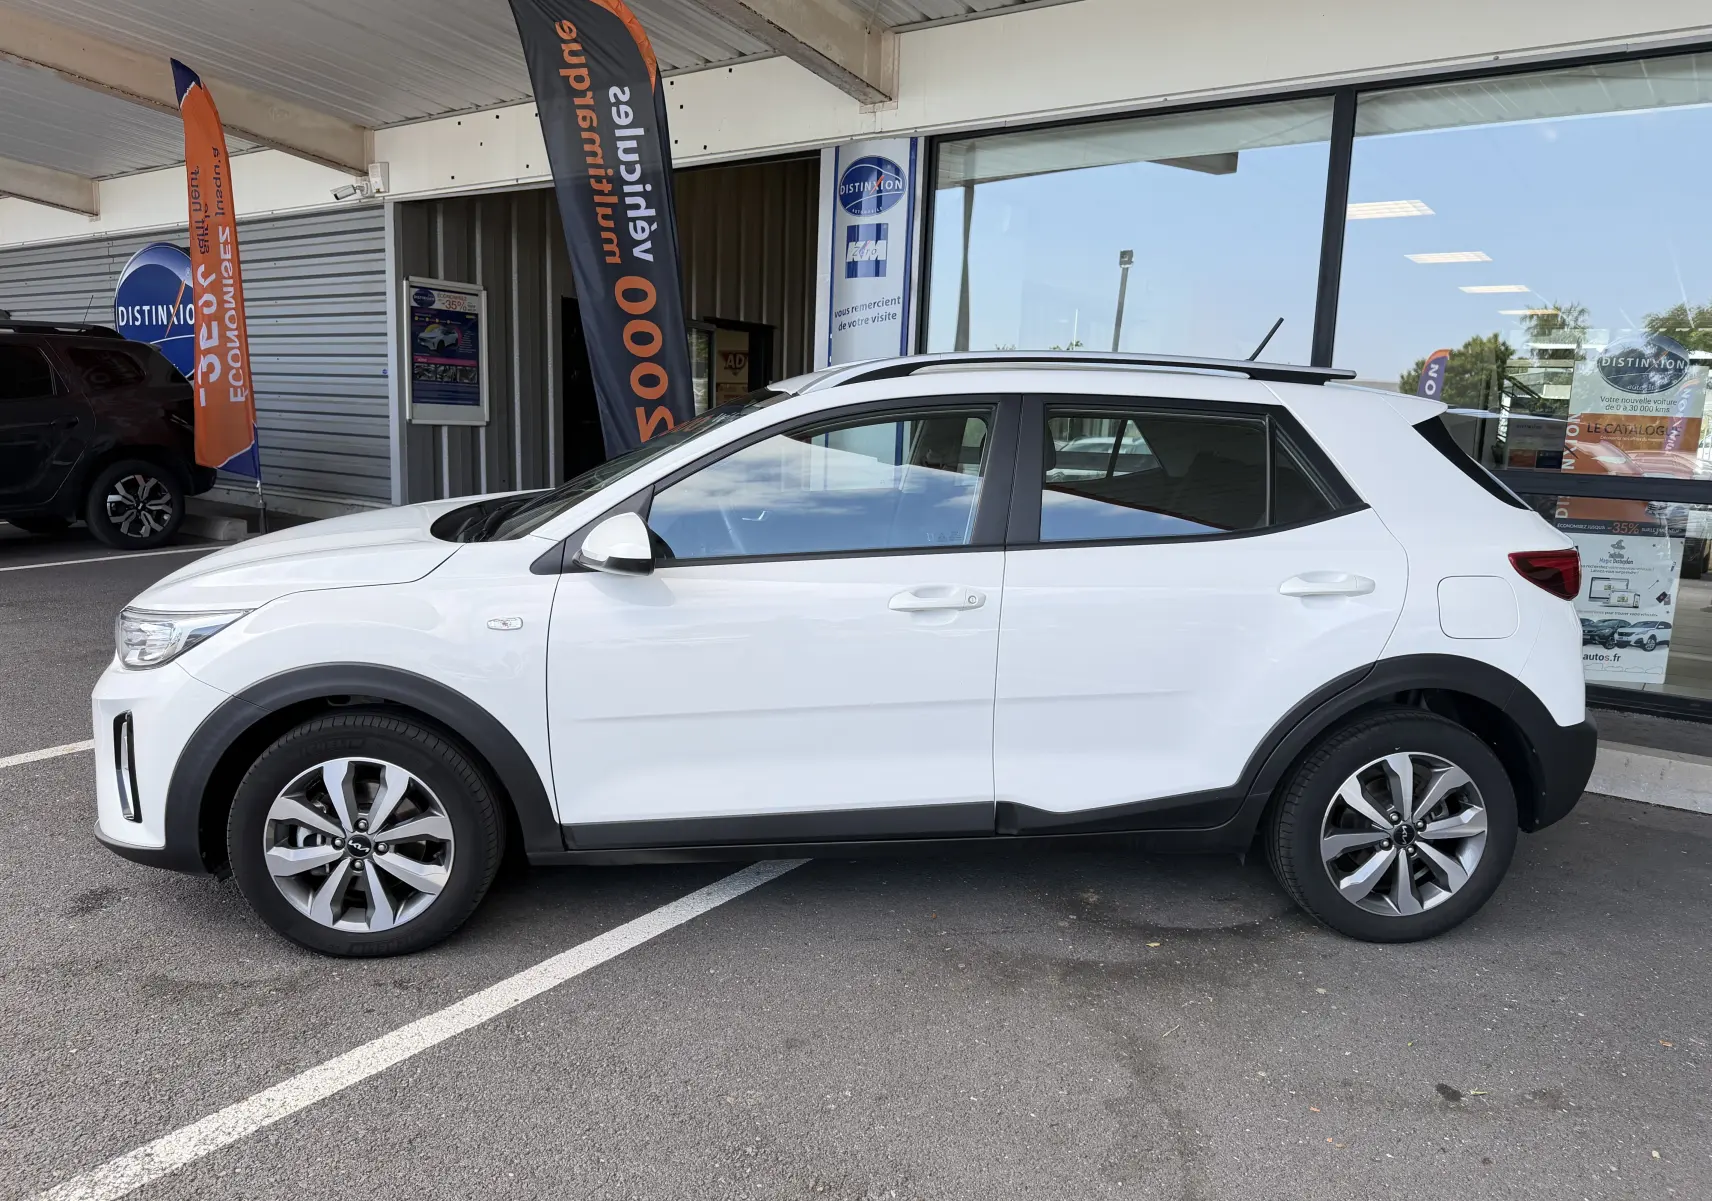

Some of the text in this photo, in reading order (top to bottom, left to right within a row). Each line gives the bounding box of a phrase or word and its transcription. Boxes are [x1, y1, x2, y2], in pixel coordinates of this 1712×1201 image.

[840, 178, 903, 195] DISTINXION
[834, 295, 902, 318] vous remercient
[118, 303, 195, 326] DISTINXIO
[838, 311, 897, 331] de votre visite
[1601, 356, 1685, 369] DISTINXION
[1621, 397, 1651, 405] nouvelle
[1653, 398, 1677, 406] voiture
[1587, 423, 1600, 434] LE
[1608, 522, 1639, 534] -35%
